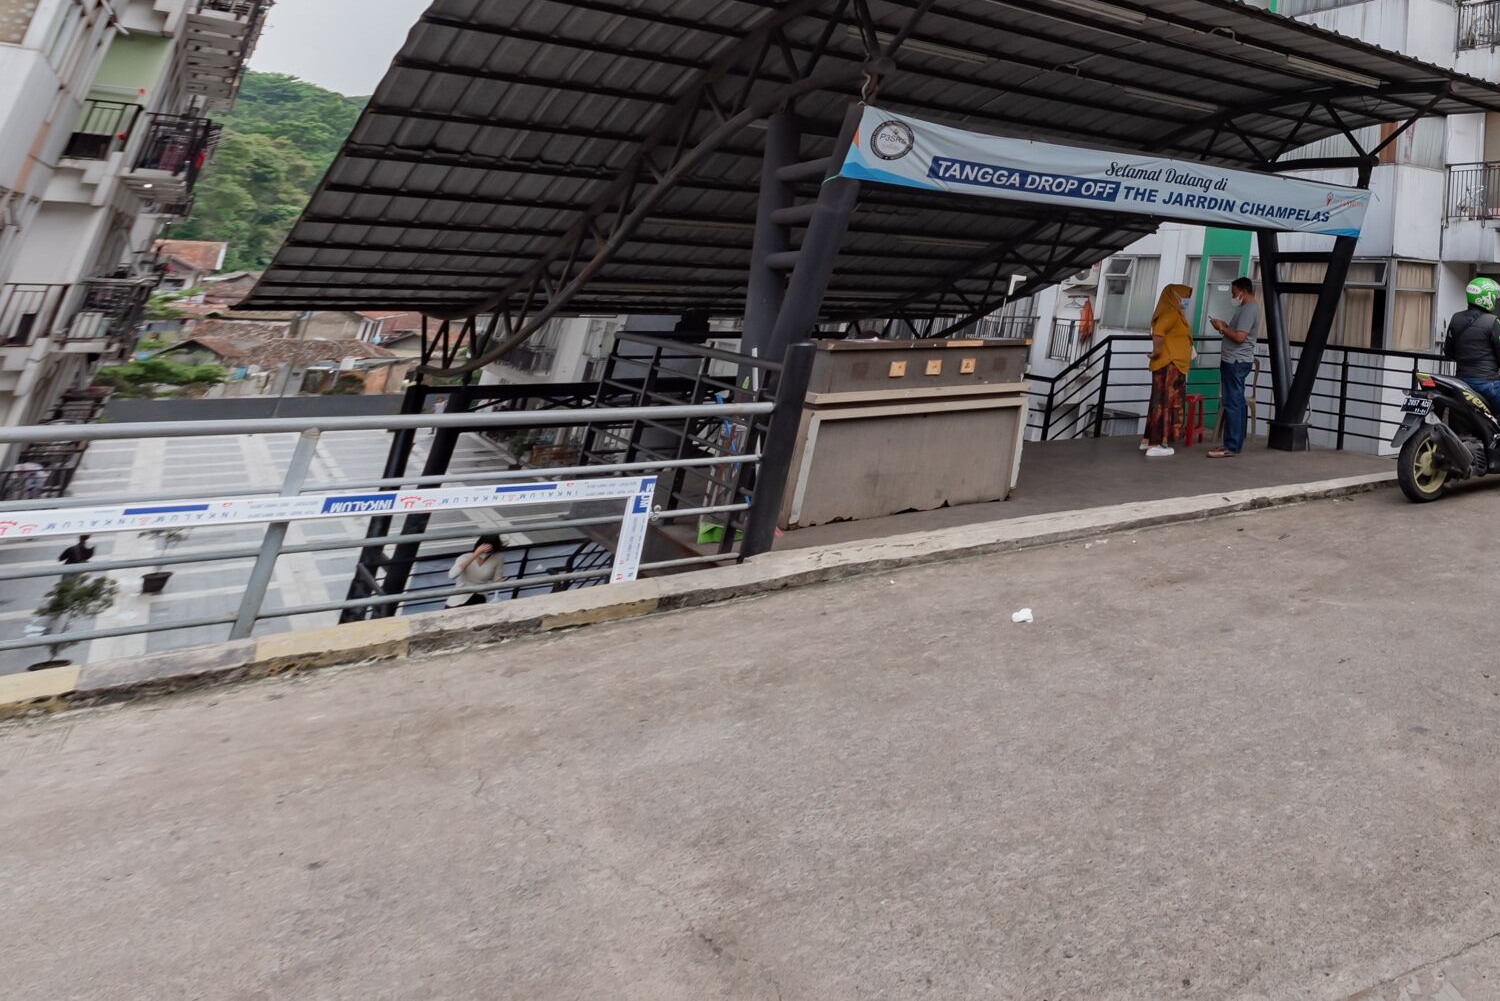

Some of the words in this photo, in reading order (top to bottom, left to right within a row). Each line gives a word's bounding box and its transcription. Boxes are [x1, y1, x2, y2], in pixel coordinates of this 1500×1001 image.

[938, 160, 1021, 188] TANGGA
[1024, 174, 1078, 195] DROP
[1081, 181, 1116, 198] OFF
[1123, 186, 1160, 203] THE
[1162, 191, 1236, 213] JARRDIN
[1239, 202, 1331, 223] CIHAMPELAS
[1105, 161, 1162, 182] Selamat
[1165, 168, 1213, 193] Datang
[1214, 177, 1229, 192] di
[329, 498, 394, 513] INKALUM
